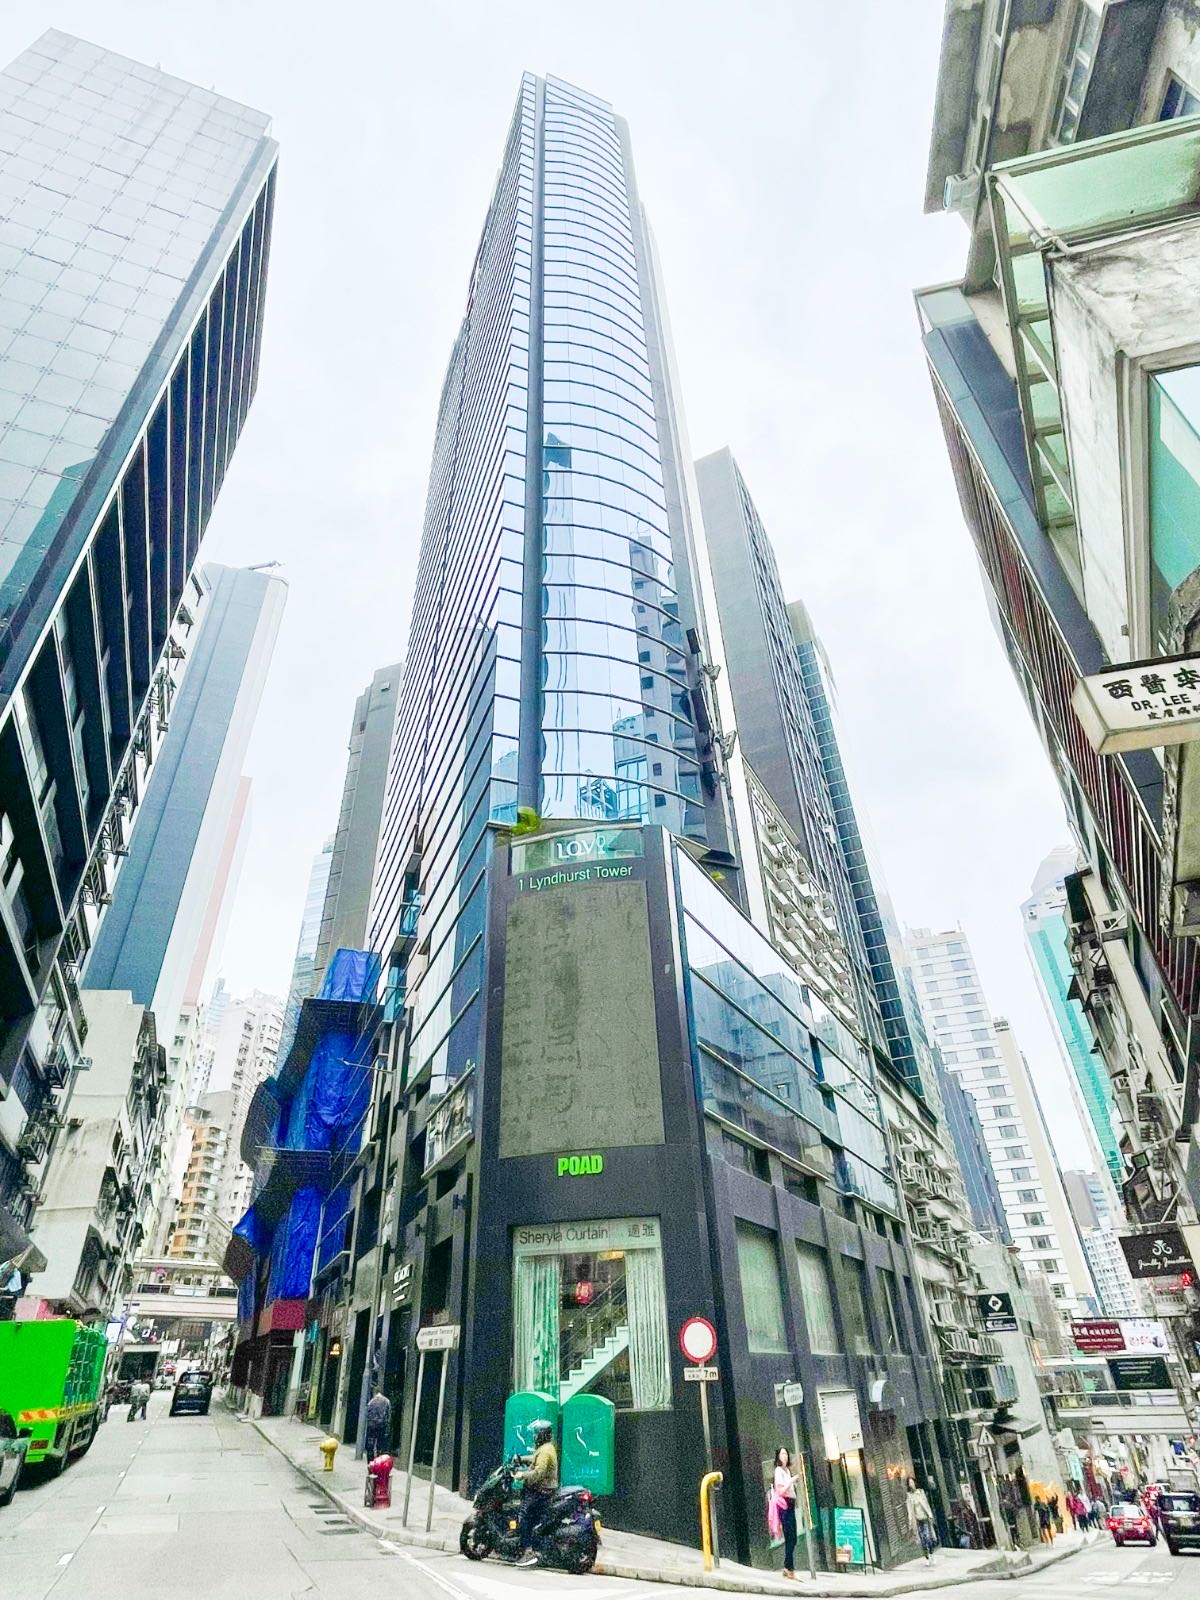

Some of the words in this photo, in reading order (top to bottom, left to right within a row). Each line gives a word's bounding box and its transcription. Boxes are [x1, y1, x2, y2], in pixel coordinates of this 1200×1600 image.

[1131, 699, 1158, 711] DR.
[1162, 694, 1191, 706] LEE
[518, 879, 524, 891] 1
[529, 868, 591, 890] Lyndhurst
[594, 865, 633, 879] Tower
[557, 1154, 604, 1177] POAD
[566, 1226, 609, 1242] Curtain
